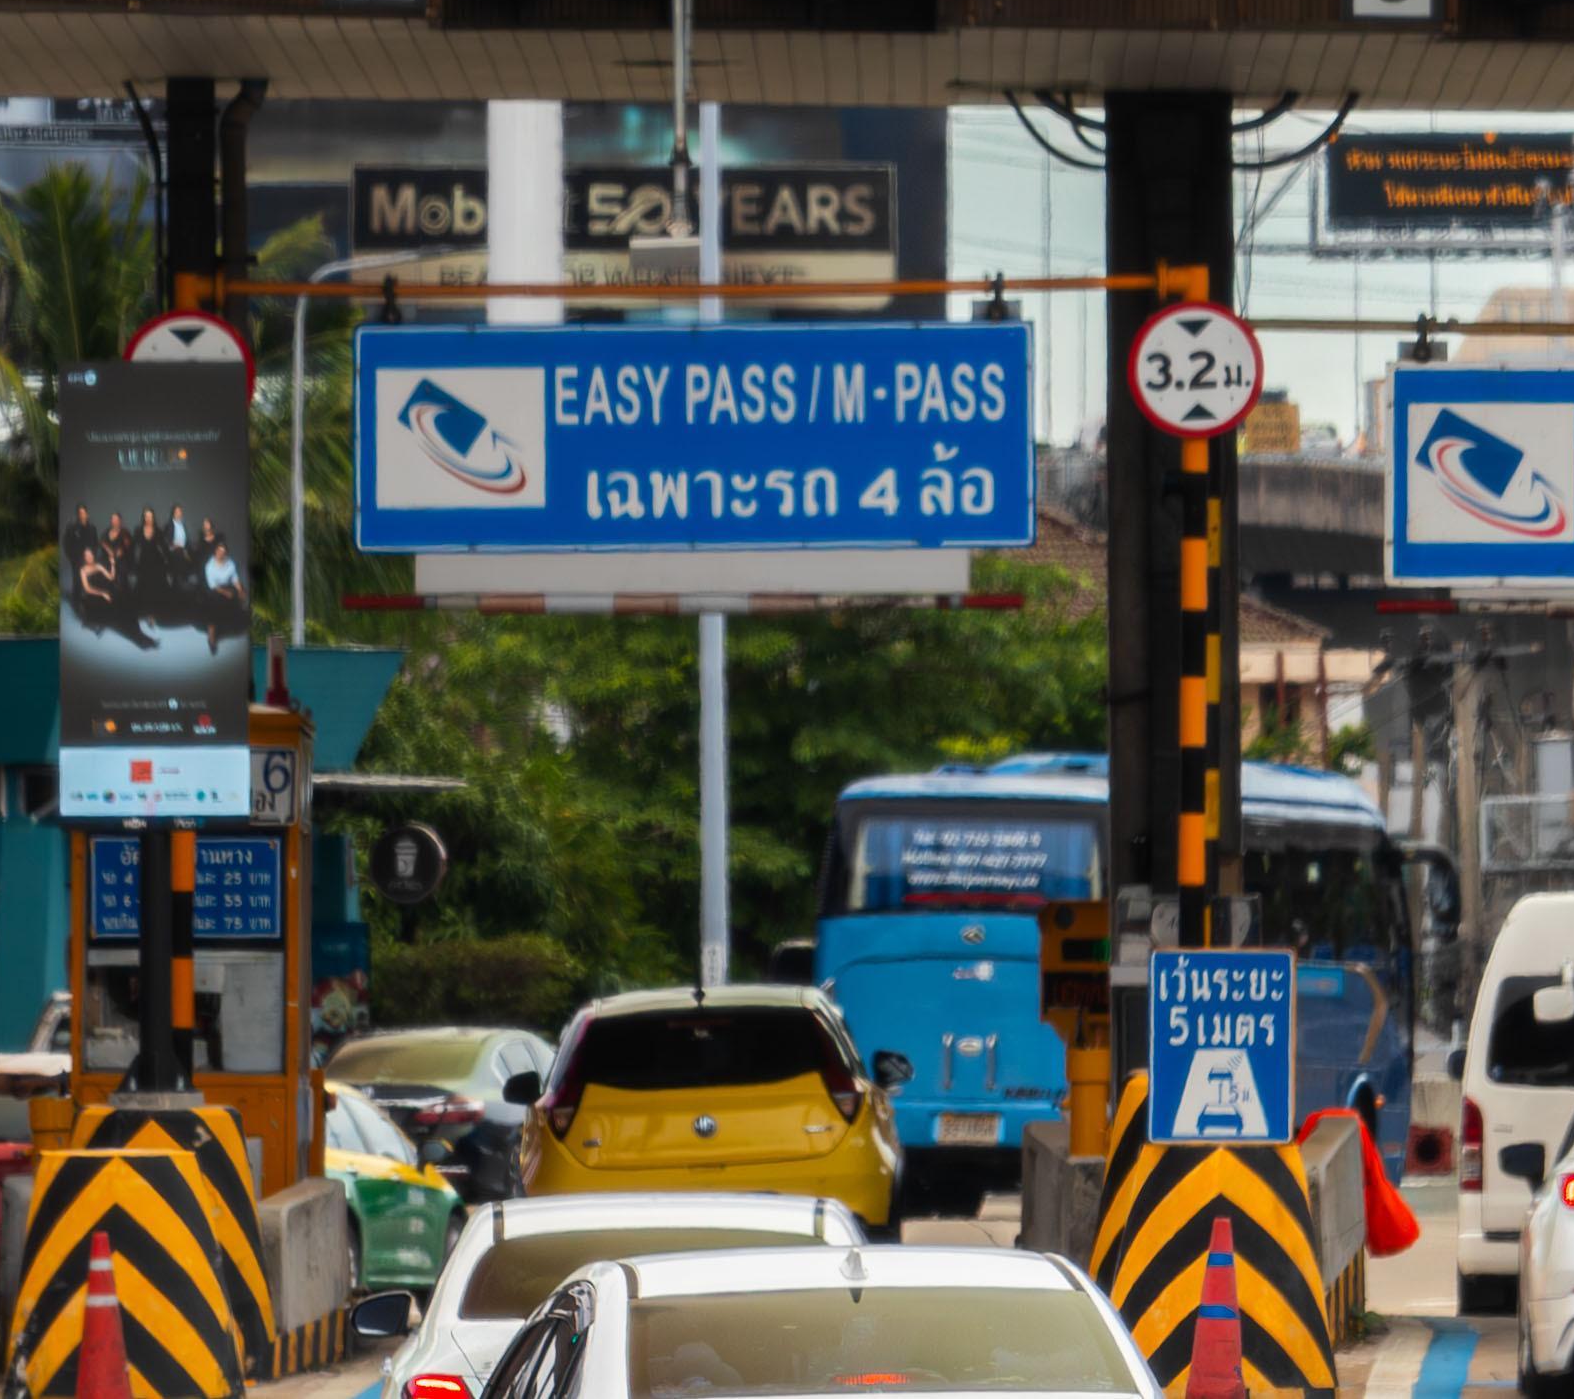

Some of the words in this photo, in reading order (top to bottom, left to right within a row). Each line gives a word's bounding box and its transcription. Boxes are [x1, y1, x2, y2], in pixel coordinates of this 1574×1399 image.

[555, 365, 671, 426] EASY
[586, 467, 838, 520] เฉพาะรถ
[858, 473, 899, 515] 4
[919, 441, 995, 515] ล้อ
[263, 751, 290, 793] 6
[1160, 955, 1283, 1002] เว้นระยะ
